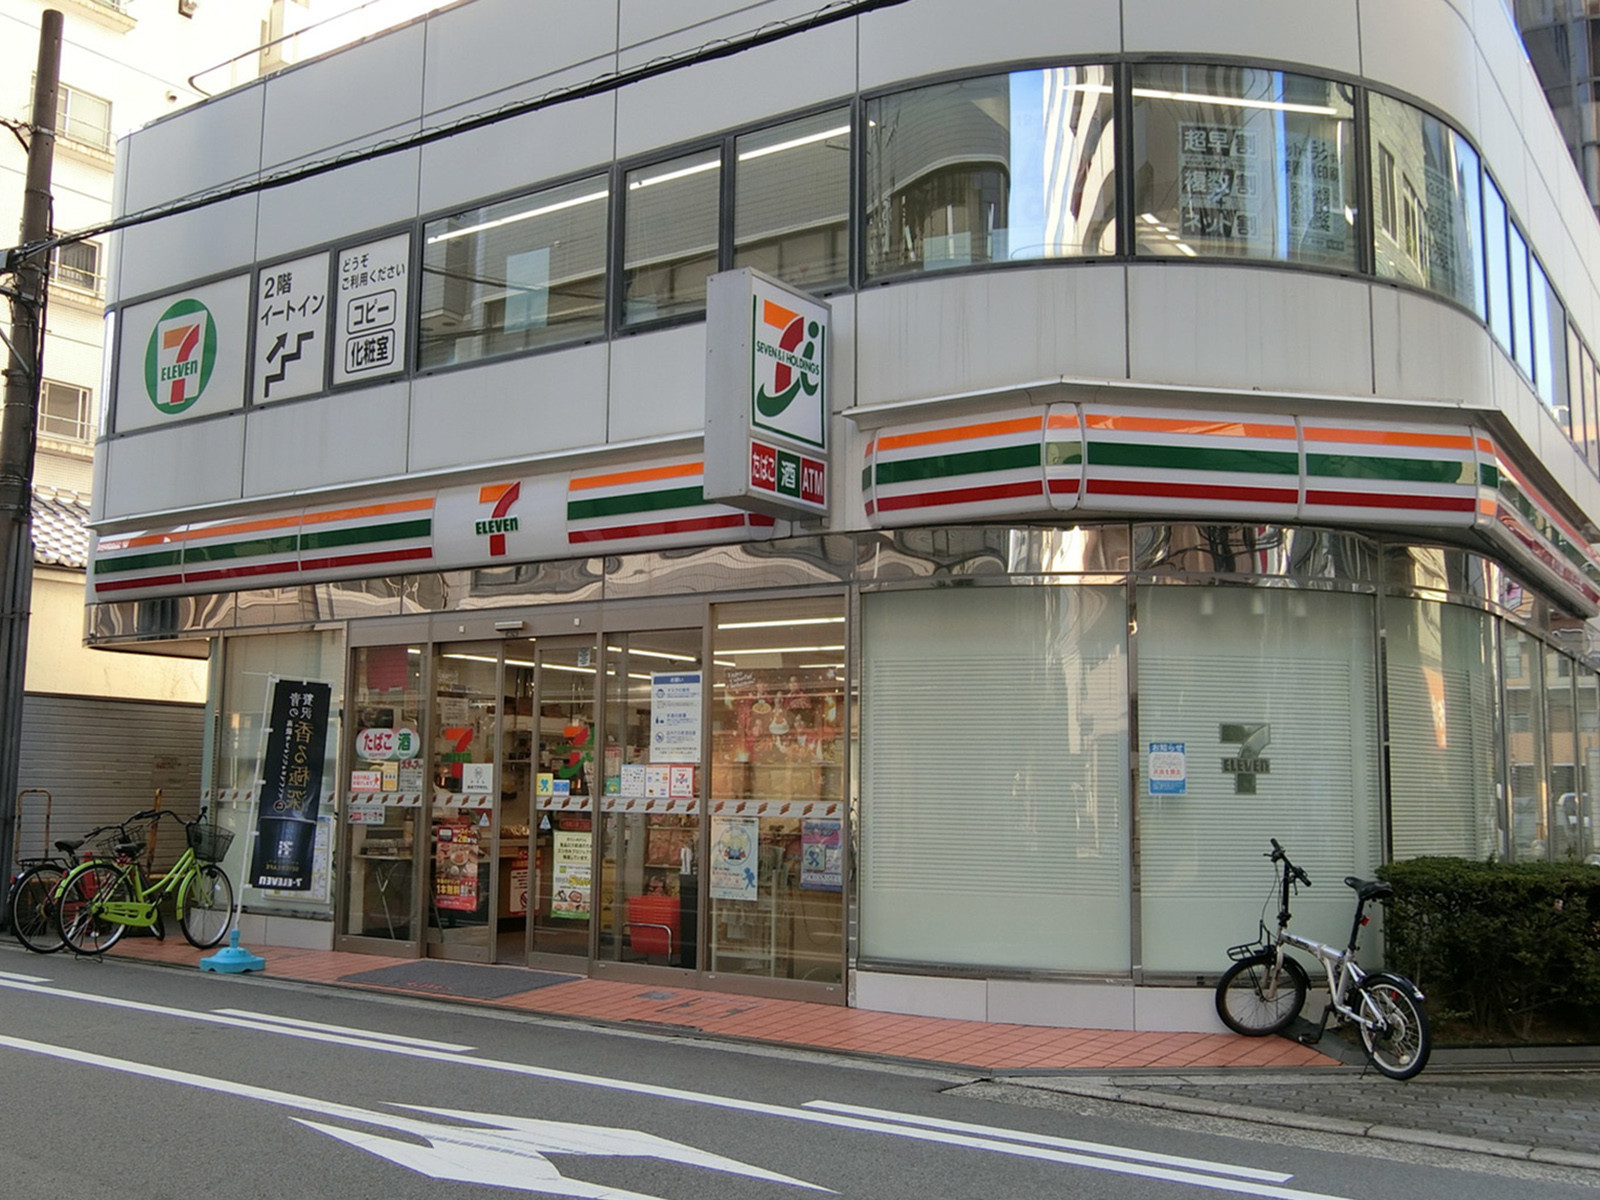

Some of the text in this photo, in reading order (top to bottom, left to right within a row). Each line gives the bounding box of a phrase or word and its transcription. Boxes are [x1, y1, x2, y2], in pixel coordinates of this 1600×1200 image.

[341, 263, 405, 291] ご利用ください
[342, 253, 369, 273] どうぞ
[264, 272, 292, 299] 2階
[261, 295, 325, 325] イートイン
[353, 298, 390, 326] コピー
[351, 335, 389, 367] 化粧室
[786, 353, 820, 376] HOLDINGS
[752, 453, 775, 482] たばこ
[780, 460, 796, 489] 酒
[802, 468, 824, 496] ATM
[363, 732, 393, 751] たばこ
[398, 733, 412, 751] 酒
